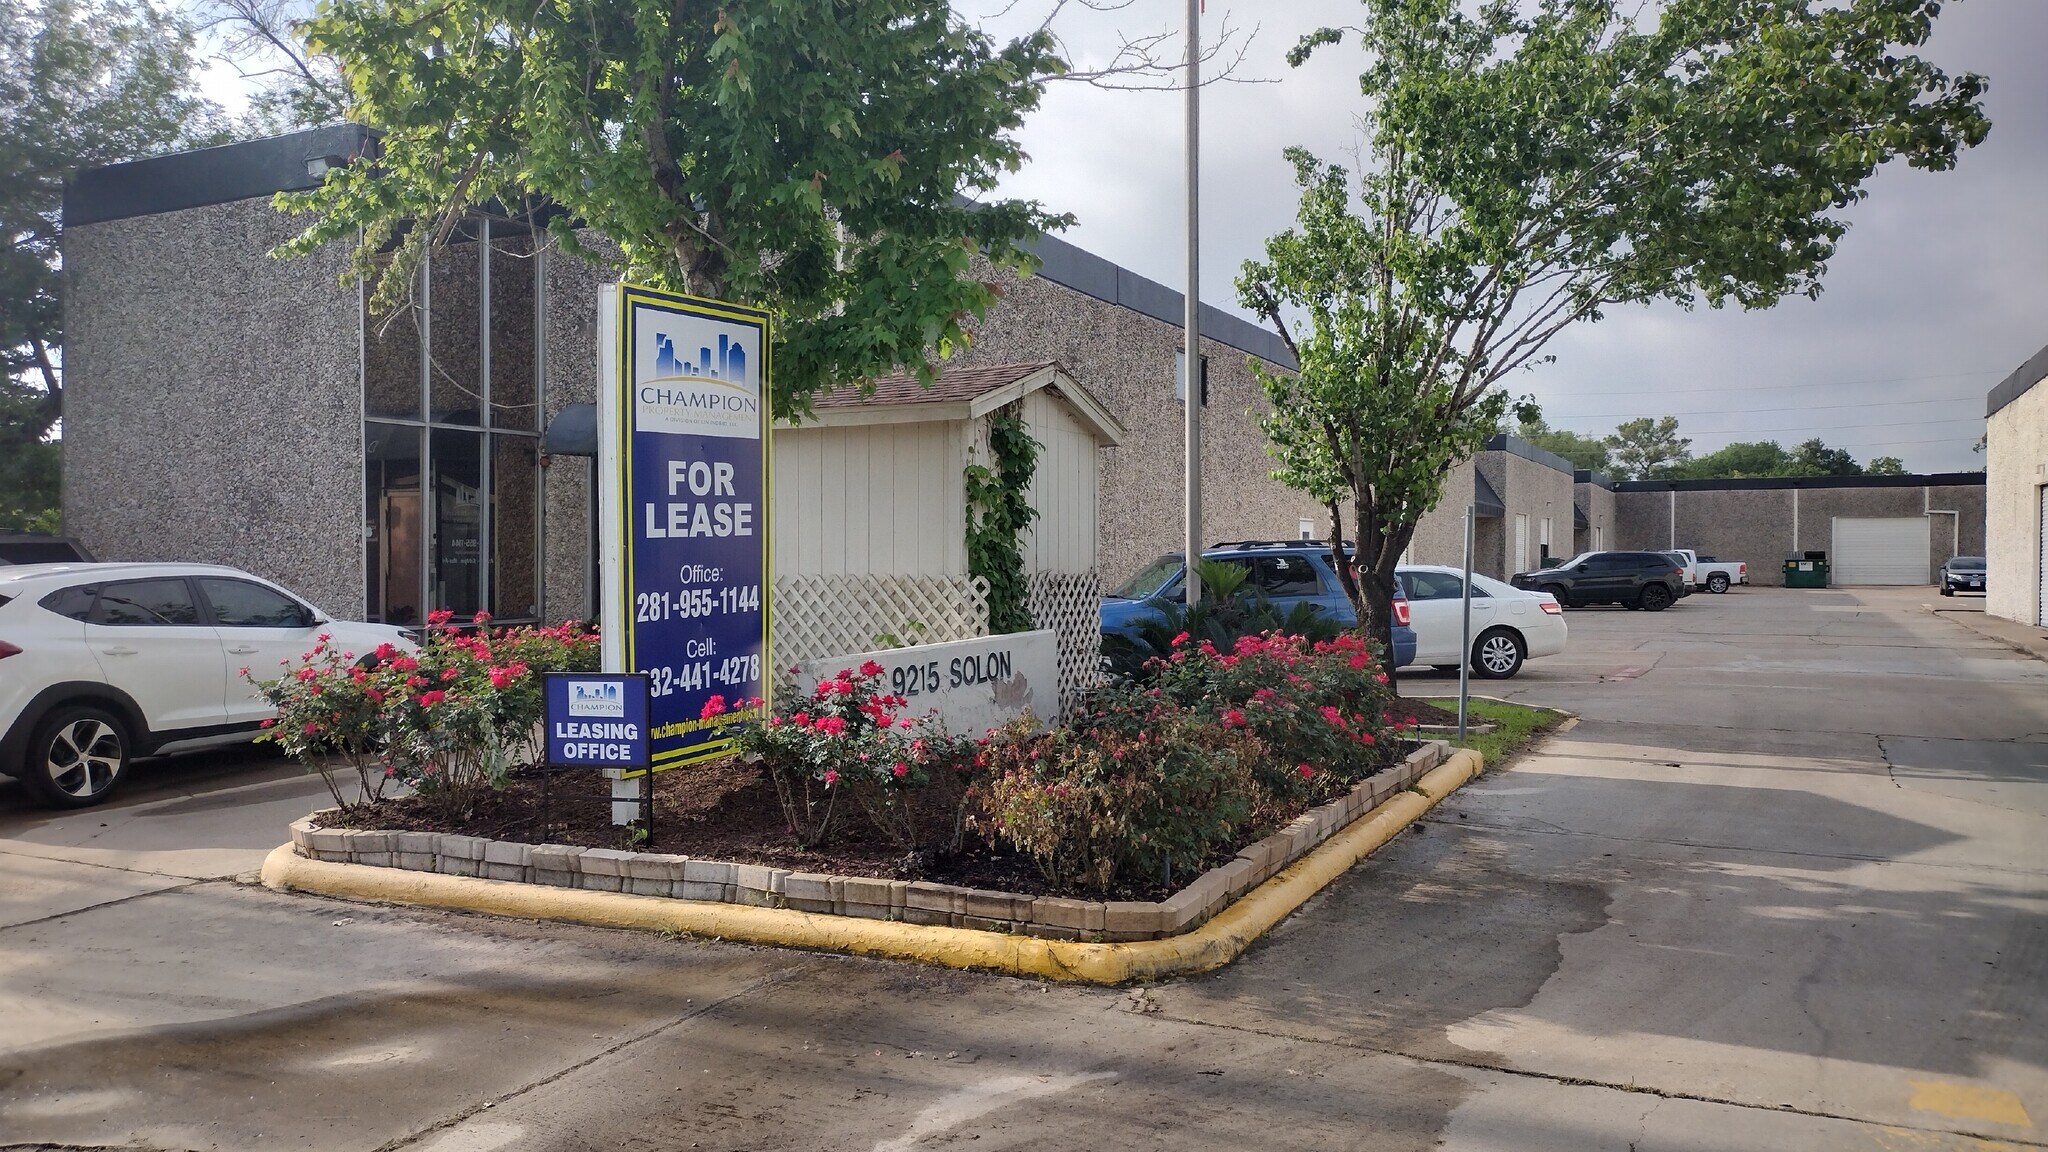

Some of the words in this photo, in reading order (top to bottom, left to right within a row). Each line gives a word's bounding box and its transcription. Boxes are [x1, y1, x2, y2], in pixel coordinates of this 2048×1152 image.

[641, 387, 757, 413] CHAMPION
[642, 405, 690, 418] PROPERTY
[694, 410, 757, 422] MANAGEMENT
[668, 460, 736, 496] FOR
[646, 503, 753, 538] LEASE
[680, 564, 724, 584] Office:
[637, 585, 760, 623] 281-955-1144
[686, 637, 717, 659] Cell:
[639, 653, 760, 698] 32-441-4278
[892, 661, 940, 697] 9215
[950, 650, 1013, 689] SOLON
[570, 702, 623, 712] CHAMPION
[556, 722, 638, 740] LEASING
[563, 742, 632, 760] OFFICE
